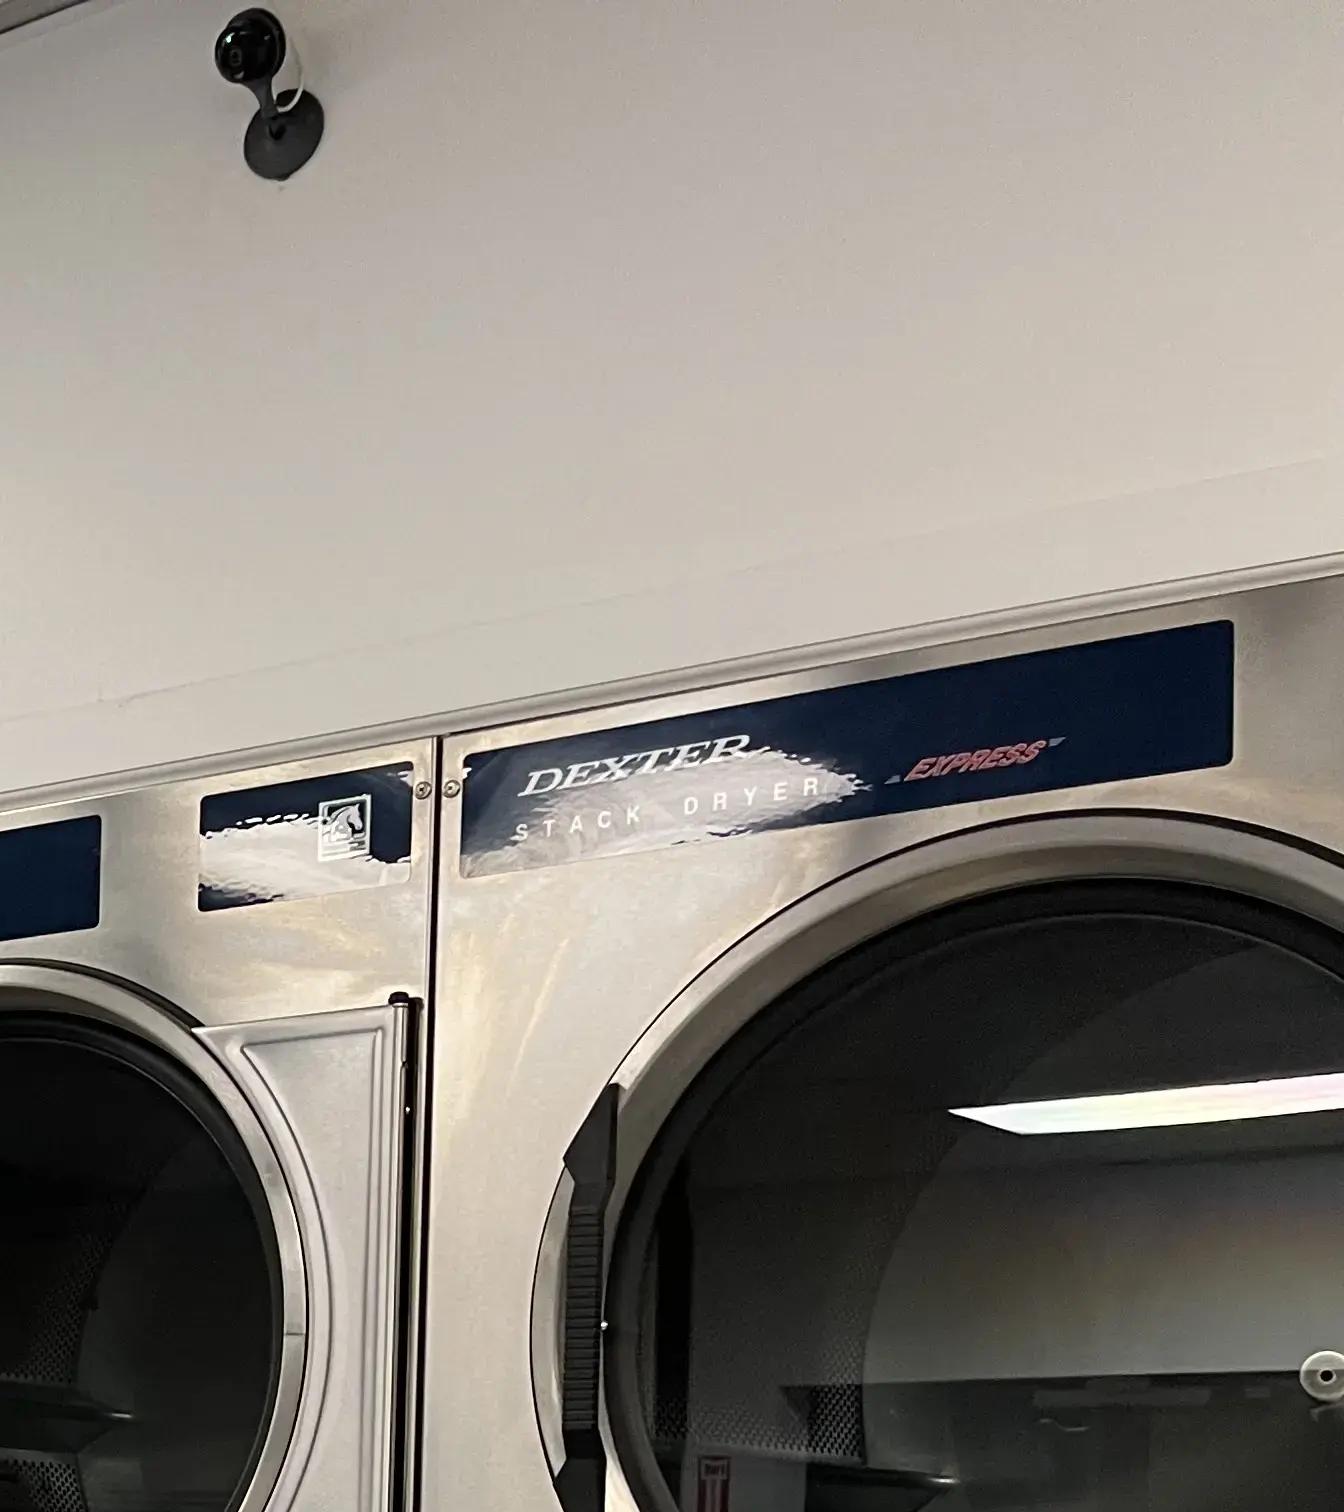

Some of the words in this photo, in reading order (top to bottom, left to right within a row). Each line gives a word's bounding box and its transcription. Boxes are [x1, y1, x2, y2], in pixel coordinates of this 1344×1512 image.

[517, 732, 752, 798] DEXTER
[903, 739, 1048, 782] EXPRESS
[510, 804, 643, 842] STACK
[683, 776, 821, 816] DRYER
